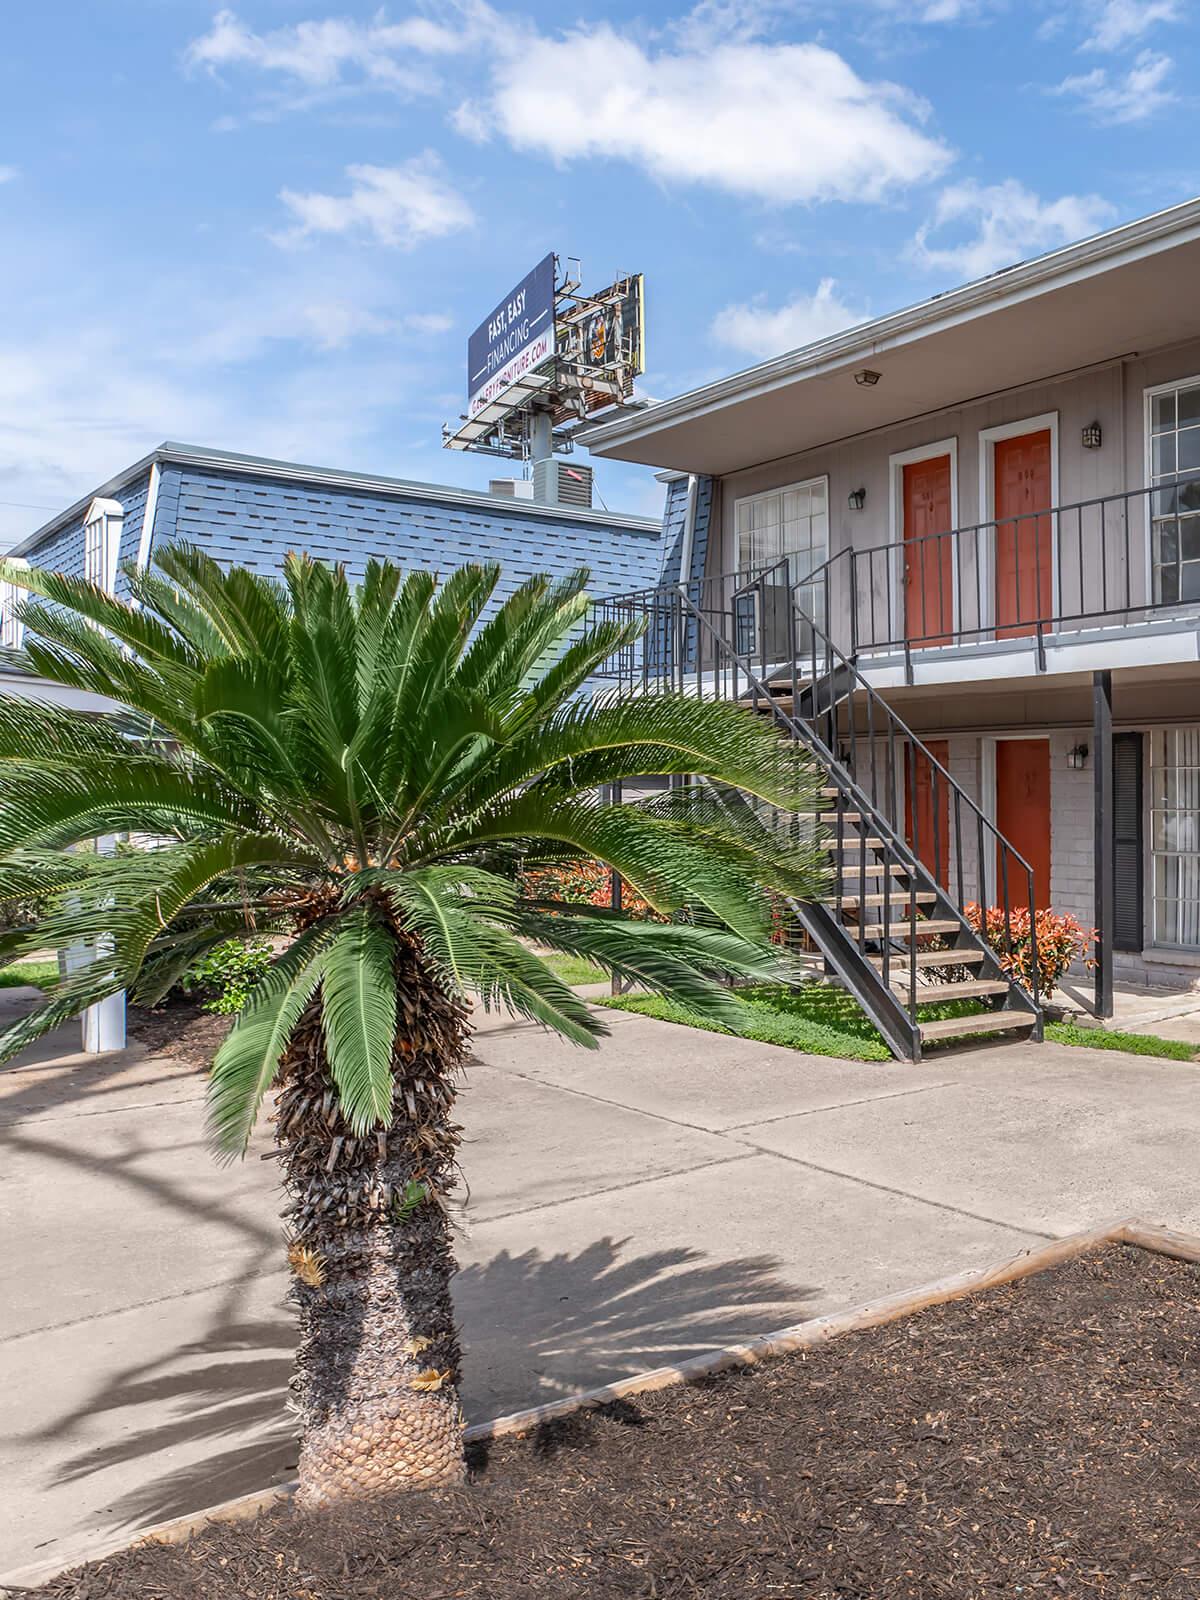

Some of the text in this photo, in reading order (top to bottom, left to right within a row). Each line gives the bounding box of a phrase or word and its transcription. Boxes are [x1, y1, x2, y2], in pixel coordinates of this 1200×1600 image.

[488, 288, 526, 344] FAST, EASY
[487, 318, 529, 374] FINANCING
